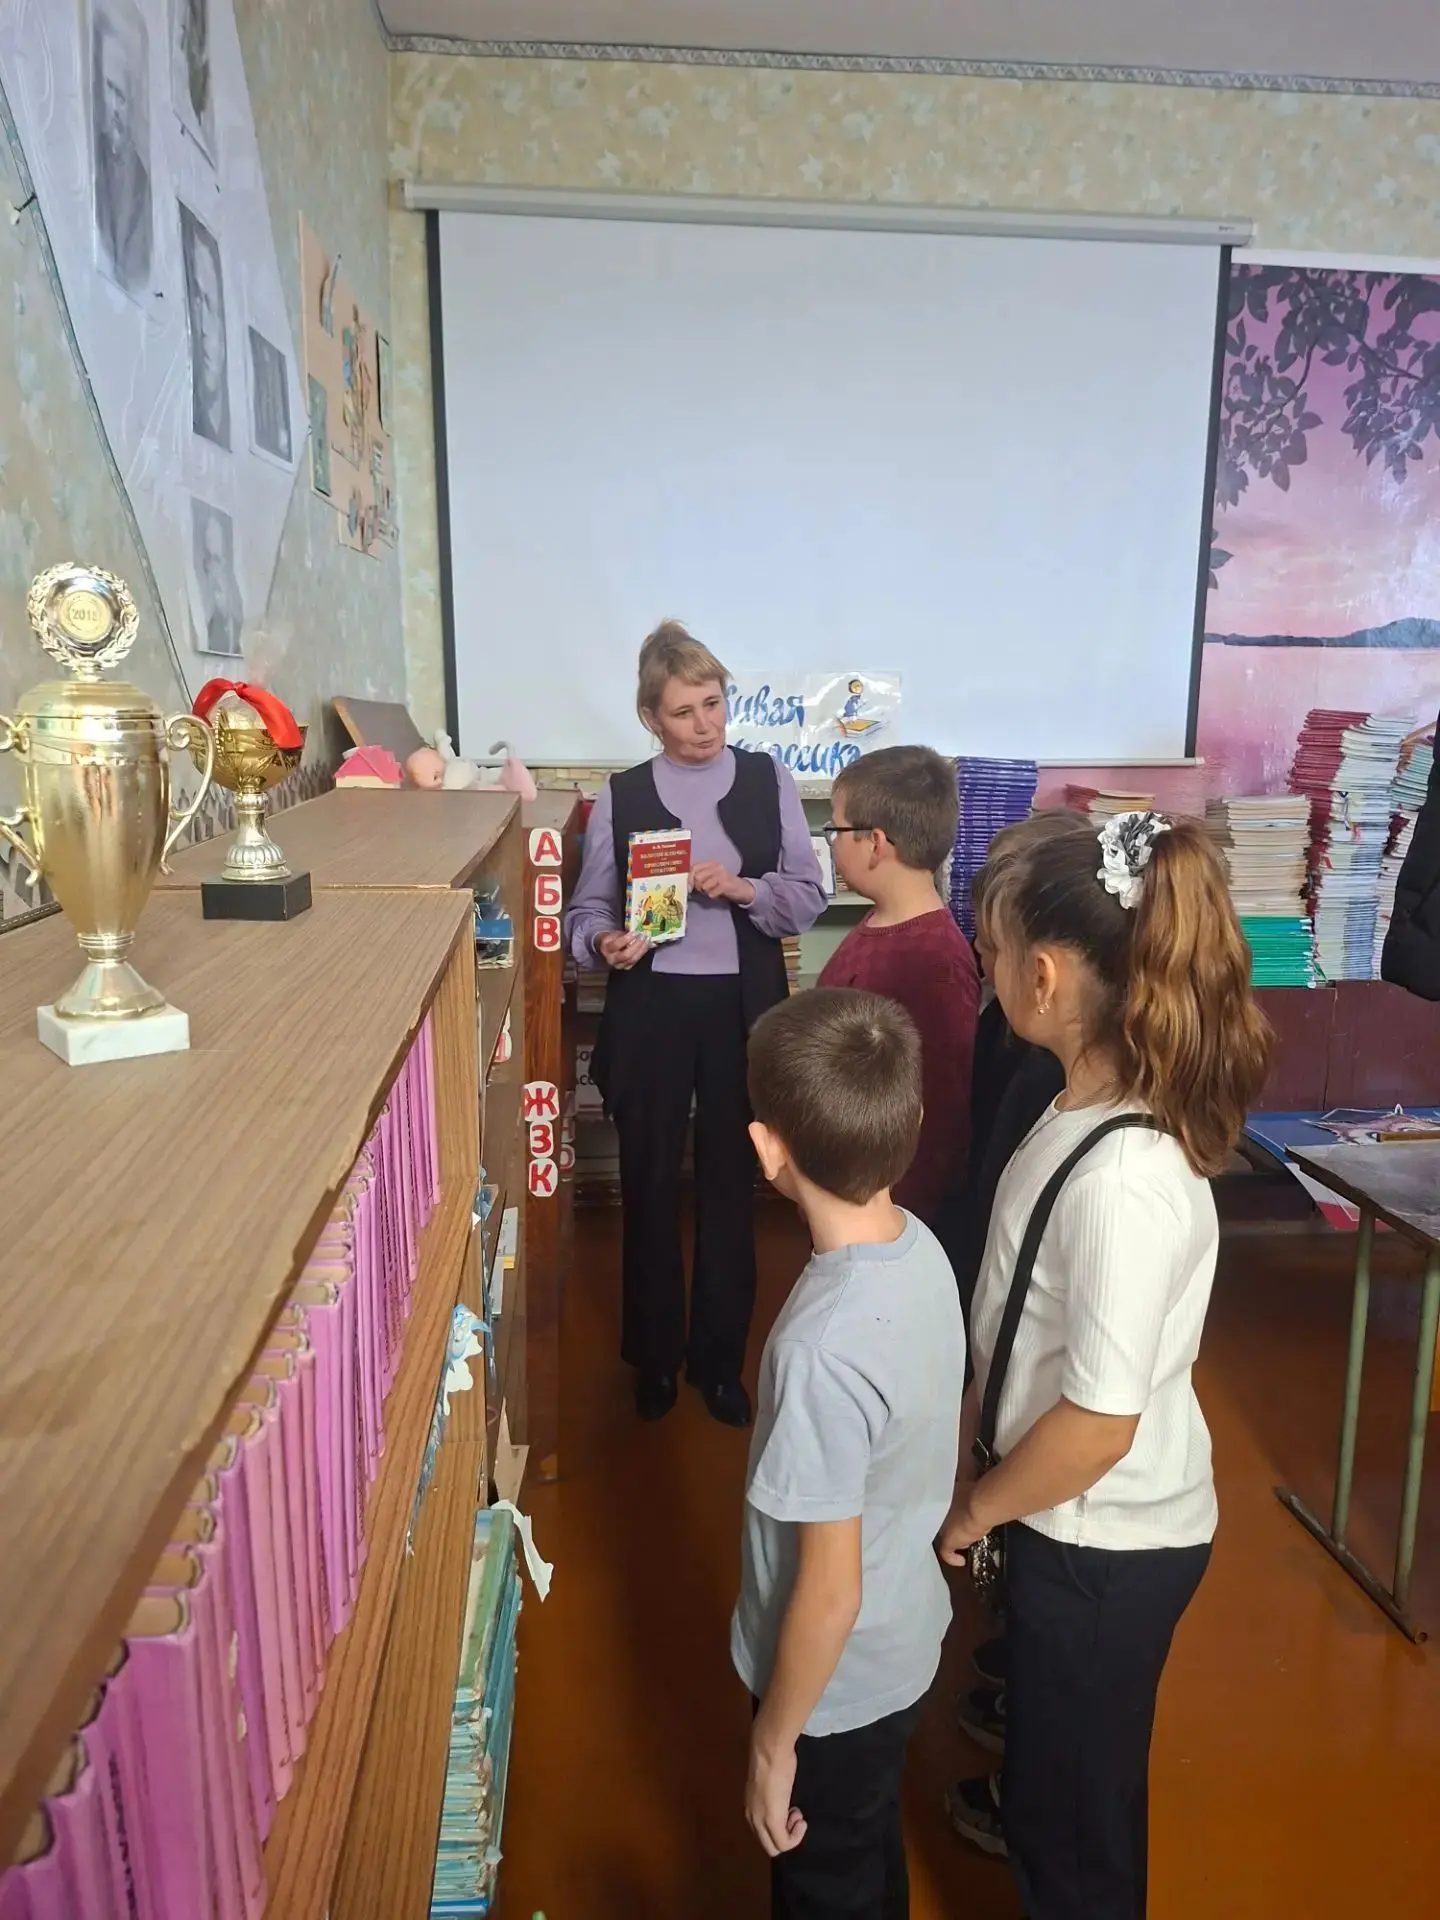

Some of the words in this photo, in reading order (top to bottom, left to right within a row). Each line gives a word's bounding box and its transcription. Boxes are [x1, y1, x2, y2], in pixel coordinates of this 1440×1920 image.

[534, 831, 561, 862] А
[538, 877, 560, 906] Б
[537, 917, 559, 948] В
[524, 1087, 558, 1118] Ж
[530, 1163, 553, 1193] К
